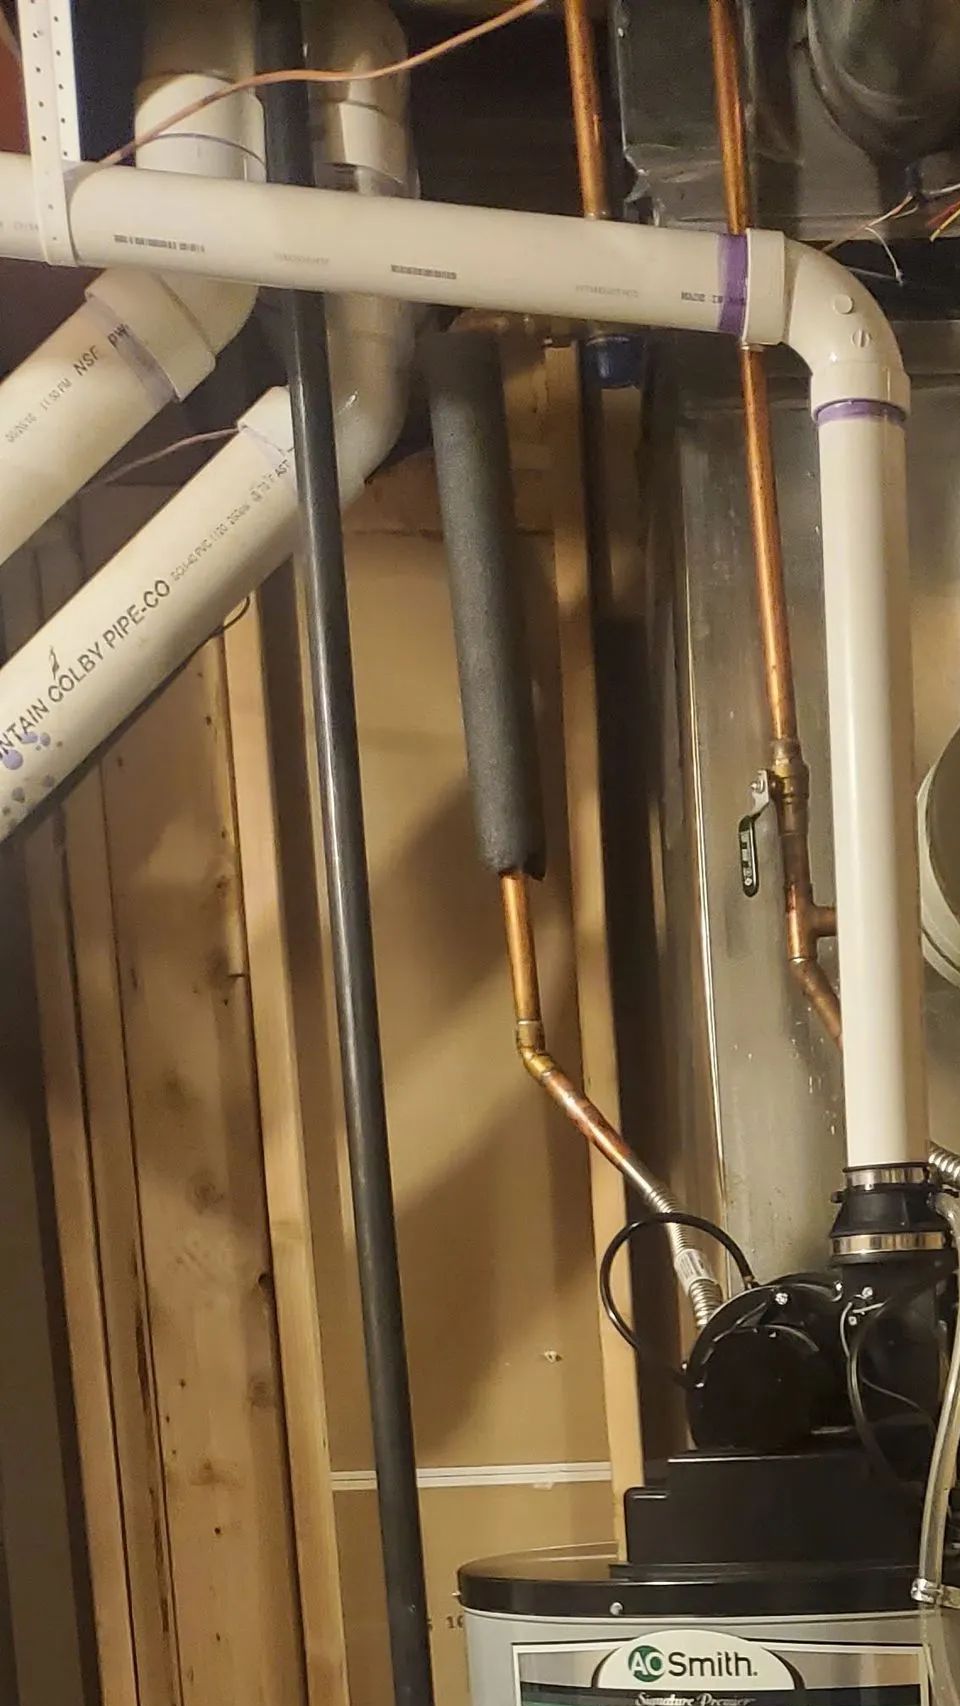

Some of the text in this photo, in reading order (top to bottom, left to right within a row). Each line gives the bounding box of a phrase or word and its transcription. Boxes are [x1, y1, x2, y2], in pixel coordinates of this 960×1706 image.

[73, 344, 99, 378] NSF
[47, 642, 104, 703] COLBY
[102, 579, 171, 649] PIPE-CO
